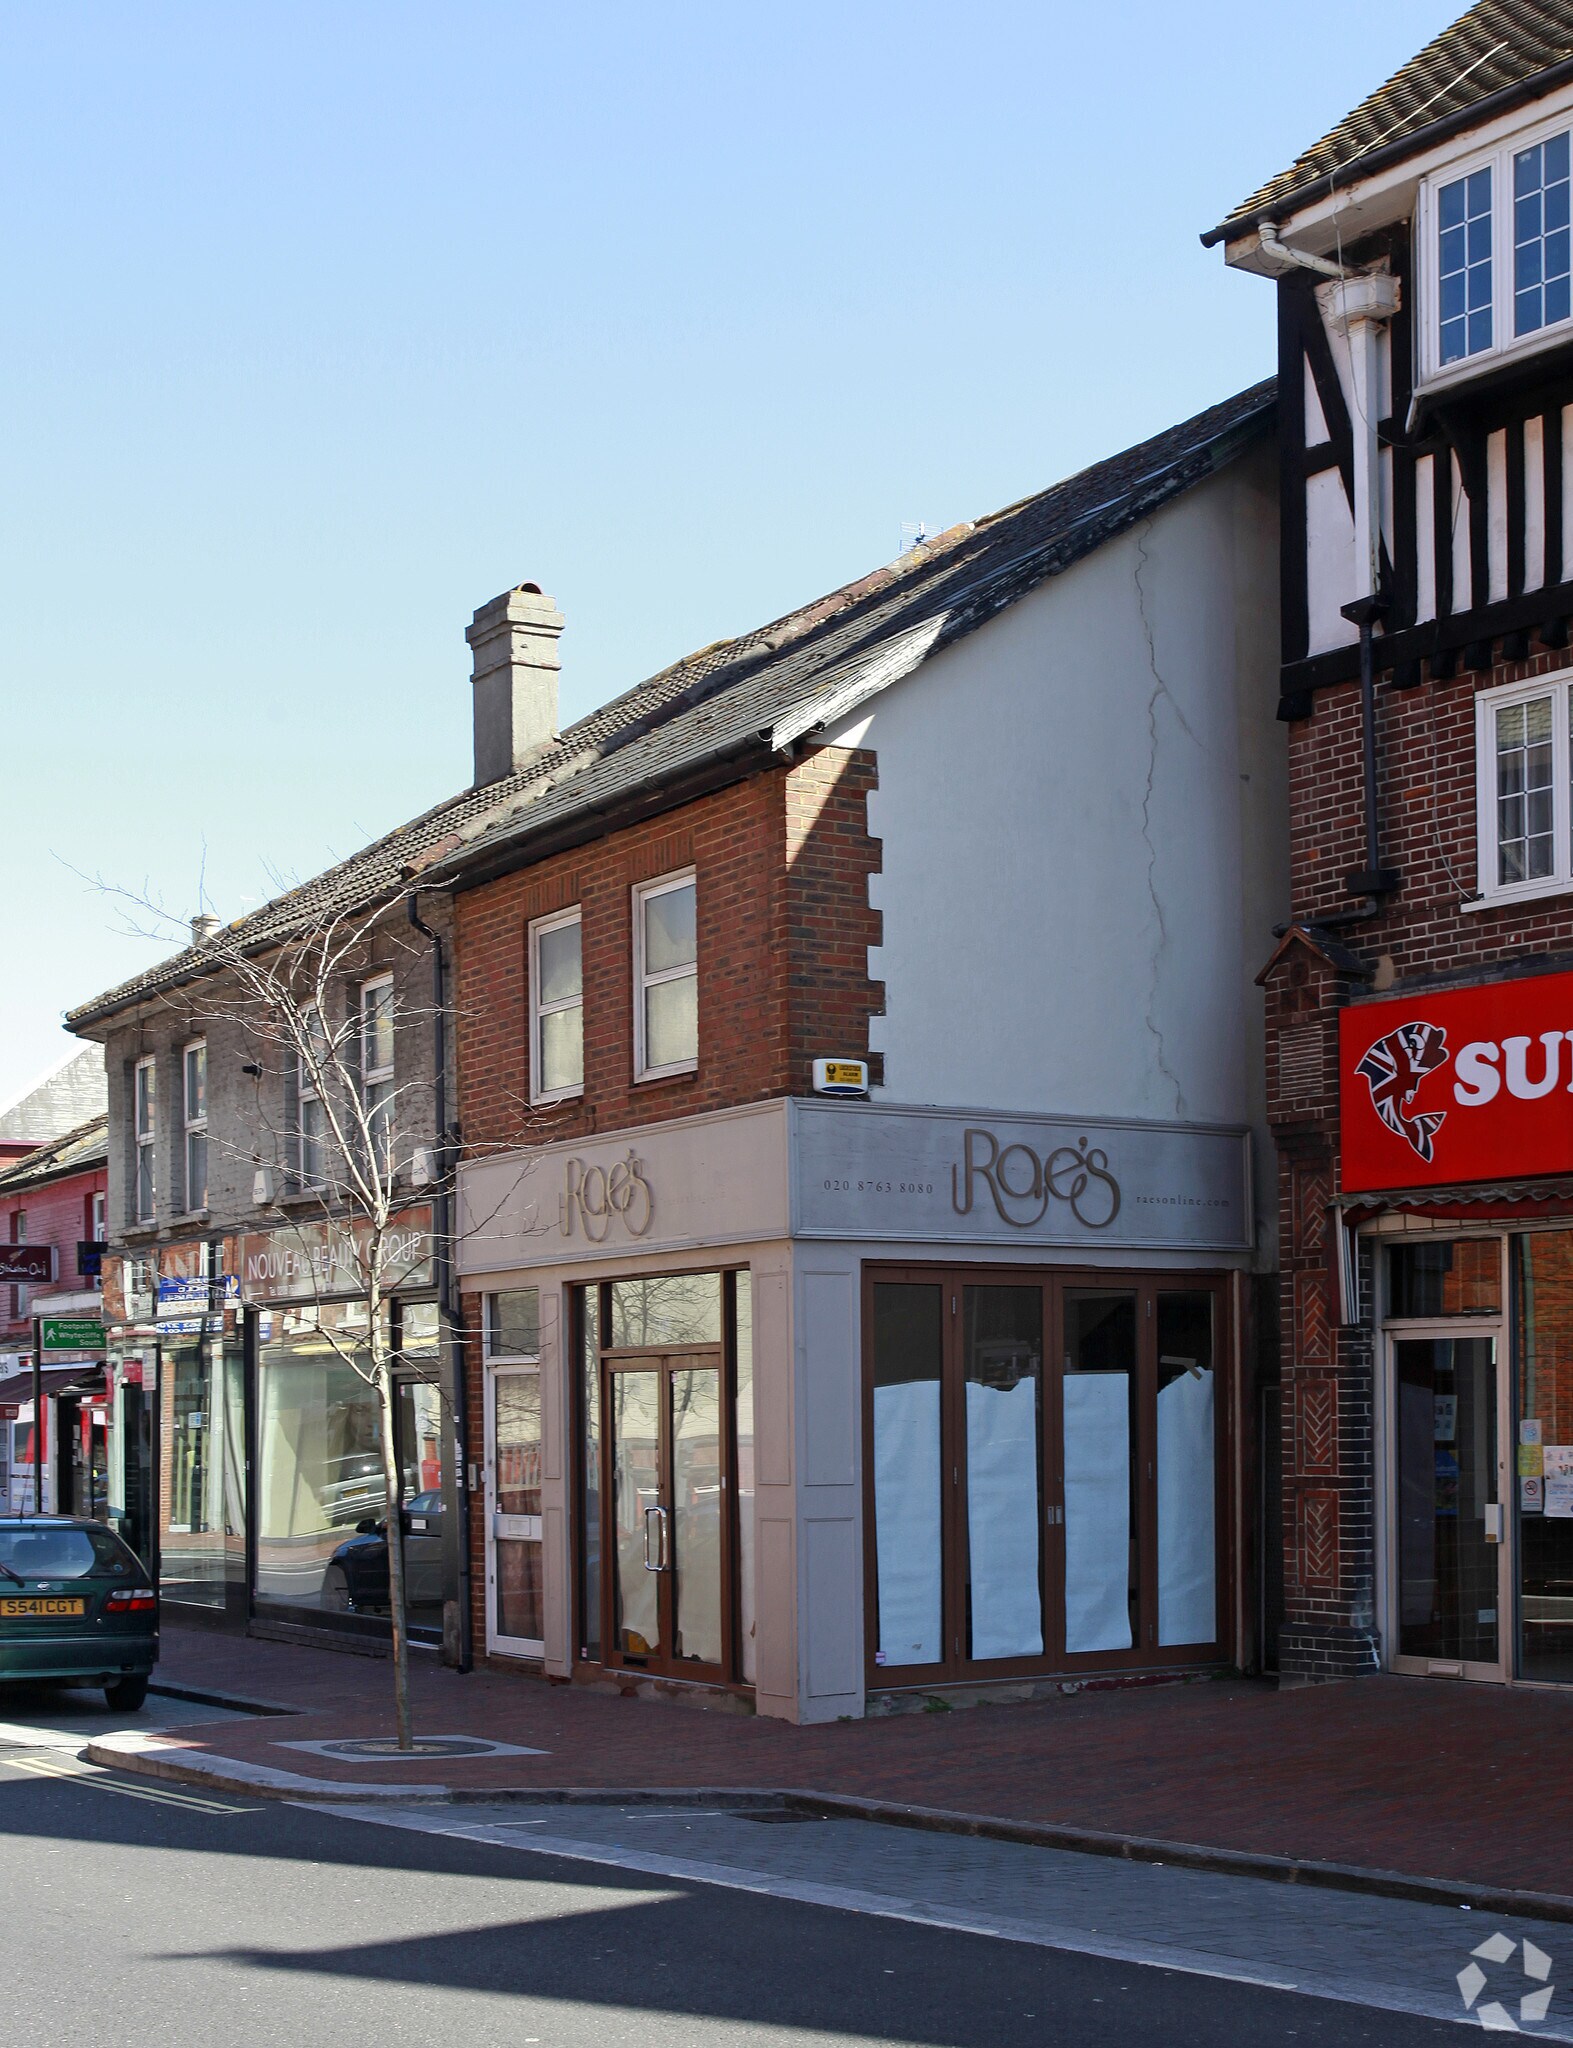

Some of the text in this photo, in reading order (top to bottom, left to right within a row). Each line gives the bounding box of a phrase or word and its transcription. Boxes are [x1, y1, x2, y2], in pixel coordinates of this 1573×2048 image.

[1453, 1030, 1573, 1107] SU
[823, 1180, 934, 1194] 020 8763 8080
[1136, 1193, 1231, 1208] raesonline.com
[58, 1322, 93, 1330] Footpath
[7, 1600, 77, 1613] S541 CGT
